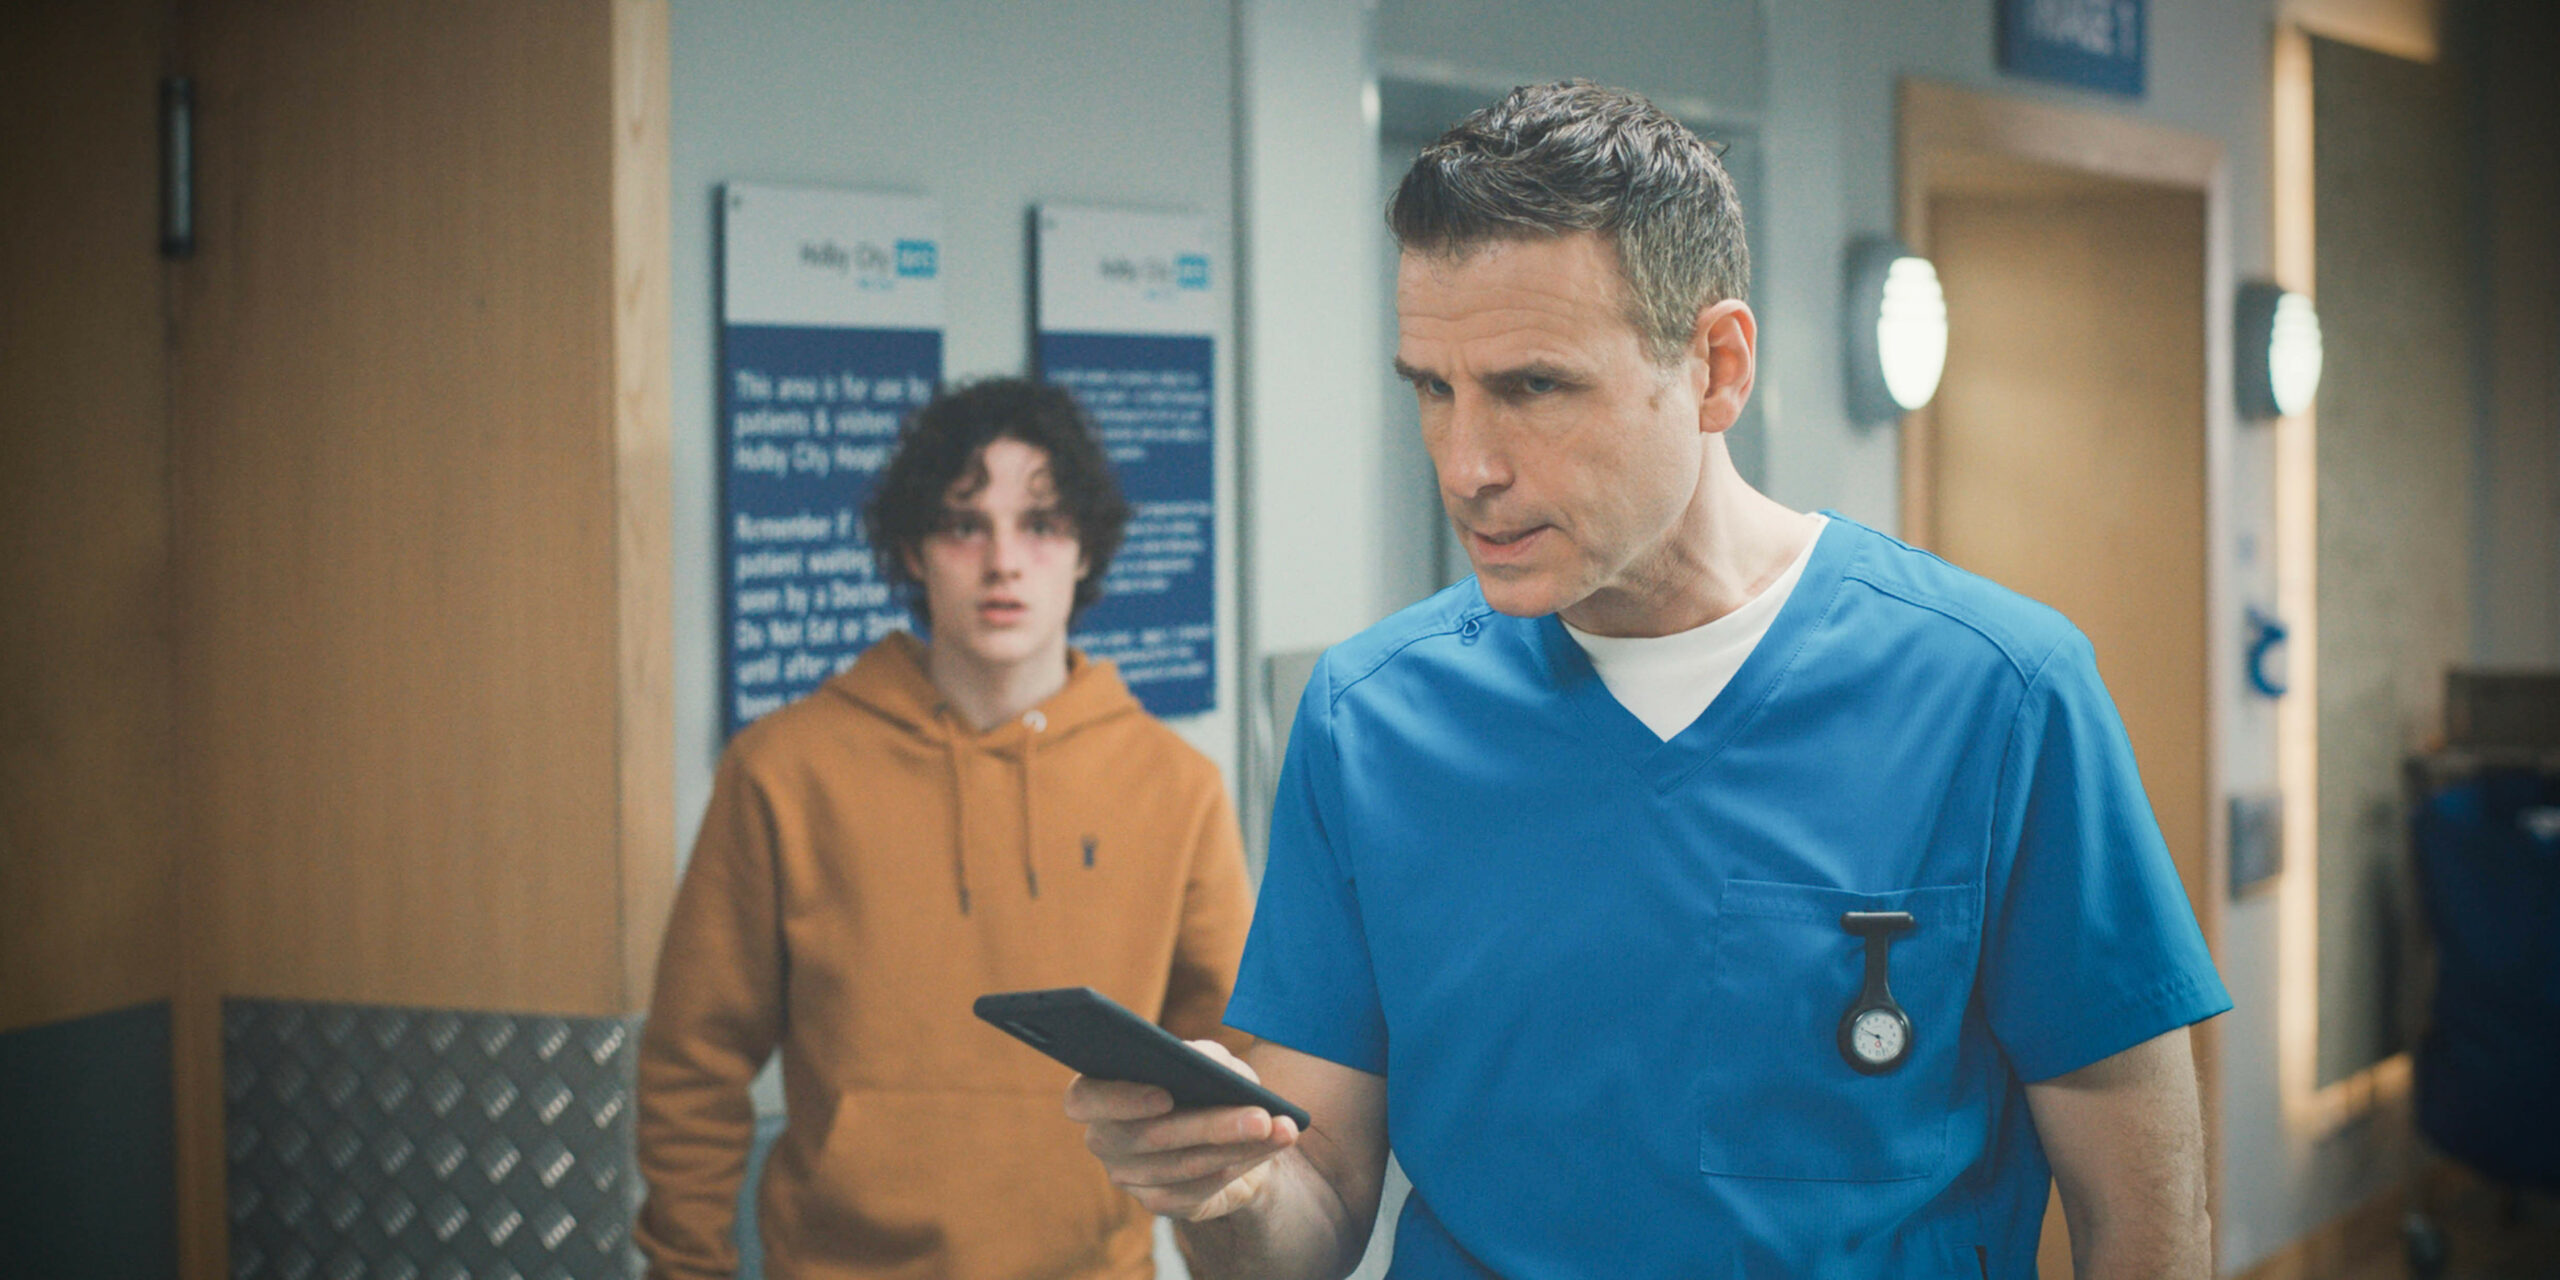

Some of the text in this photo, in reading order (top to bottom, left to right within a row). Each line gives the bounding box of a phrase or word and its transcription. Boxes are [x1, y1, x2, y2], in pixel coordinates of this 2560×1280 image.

[735, 371, 771, 400] This
[778, 380, 817, 399] area
[824, 376, 837, 399] is
[842, 373, 868, 399] for
[874, 380, 902, 400] use
[734, 411, 810, 439] patients
[814, 408, 830, 435] &
[734, 443, 788, 478] Holby
[792, 443, 830, 477] City
[735, 513, 832, 541] Remember
[735, 550, 874, 582] patient waiting
[736, 589, 780, 612] seen
[785, 584, 807, 613] by
[814, 589, 827, 609] a
[735, 618, 764, 649] Do
[768, 620, 801, 646] Not
[806, 615, 838, 644] Eat
[842, 619, 860, 642] or
[736, 652, 780, 684] until
[784, 650, 830, 680] after
